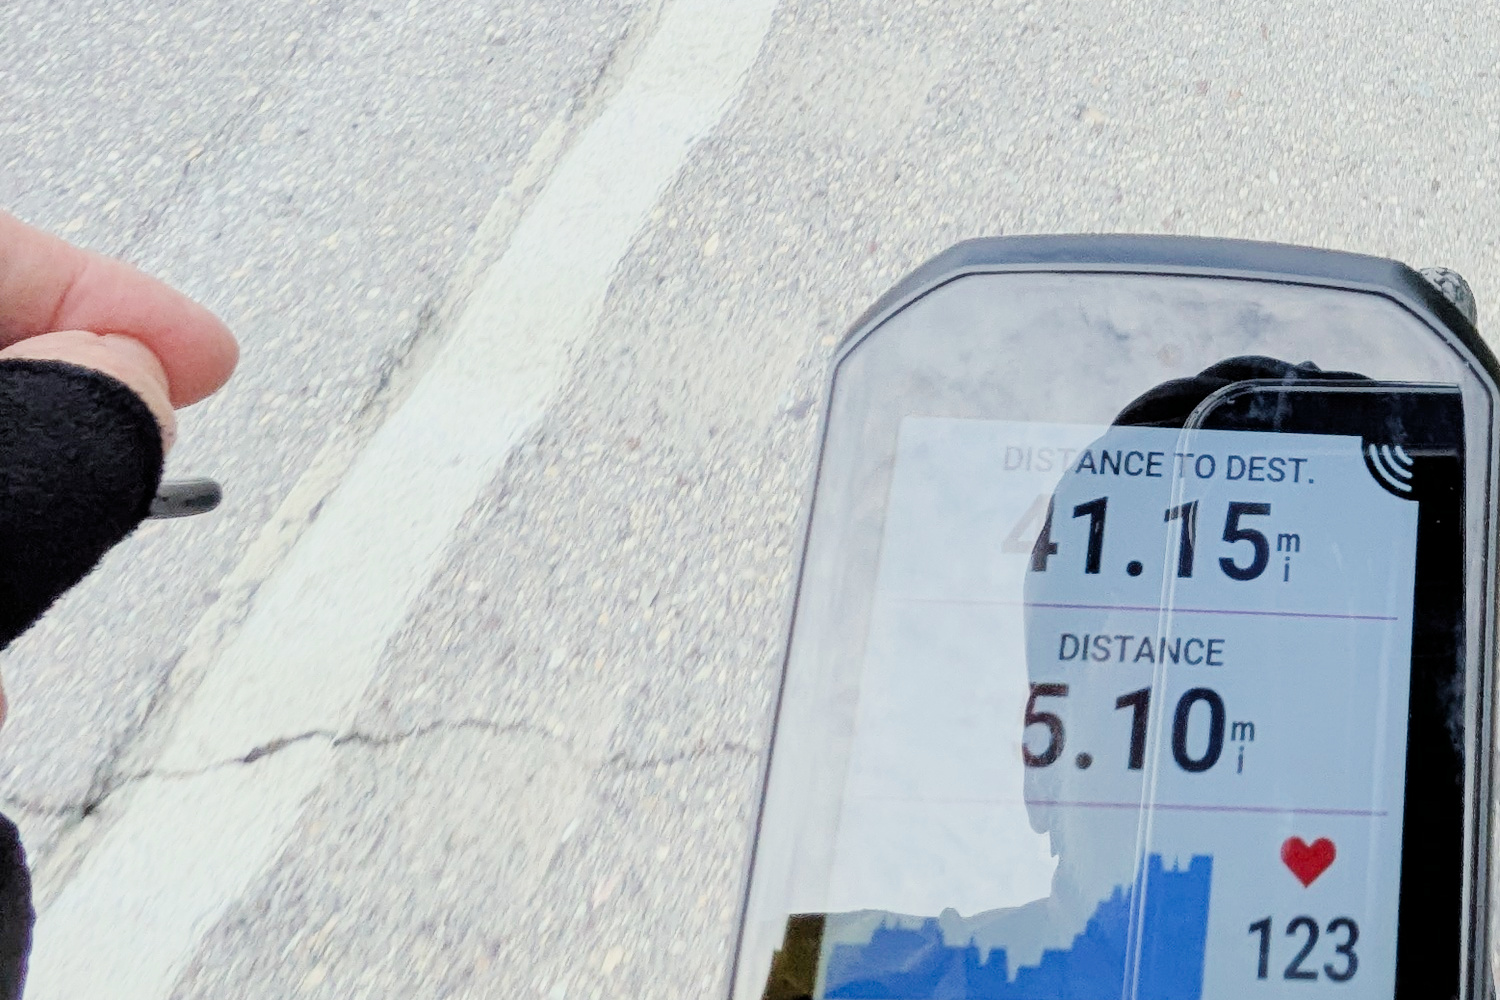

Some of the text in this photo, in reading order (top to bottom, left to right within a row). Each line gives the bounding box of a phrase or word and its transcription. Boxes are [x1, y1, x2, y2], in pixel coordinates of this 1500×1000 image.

[1003, 445, 1316, 485] DISTANCE TO DEST.
[1058, 633, 1226, 667] DISTANCE
[1022, 682, 1226, 774] 5.10
[1247, 914, 1361, 984] 123
